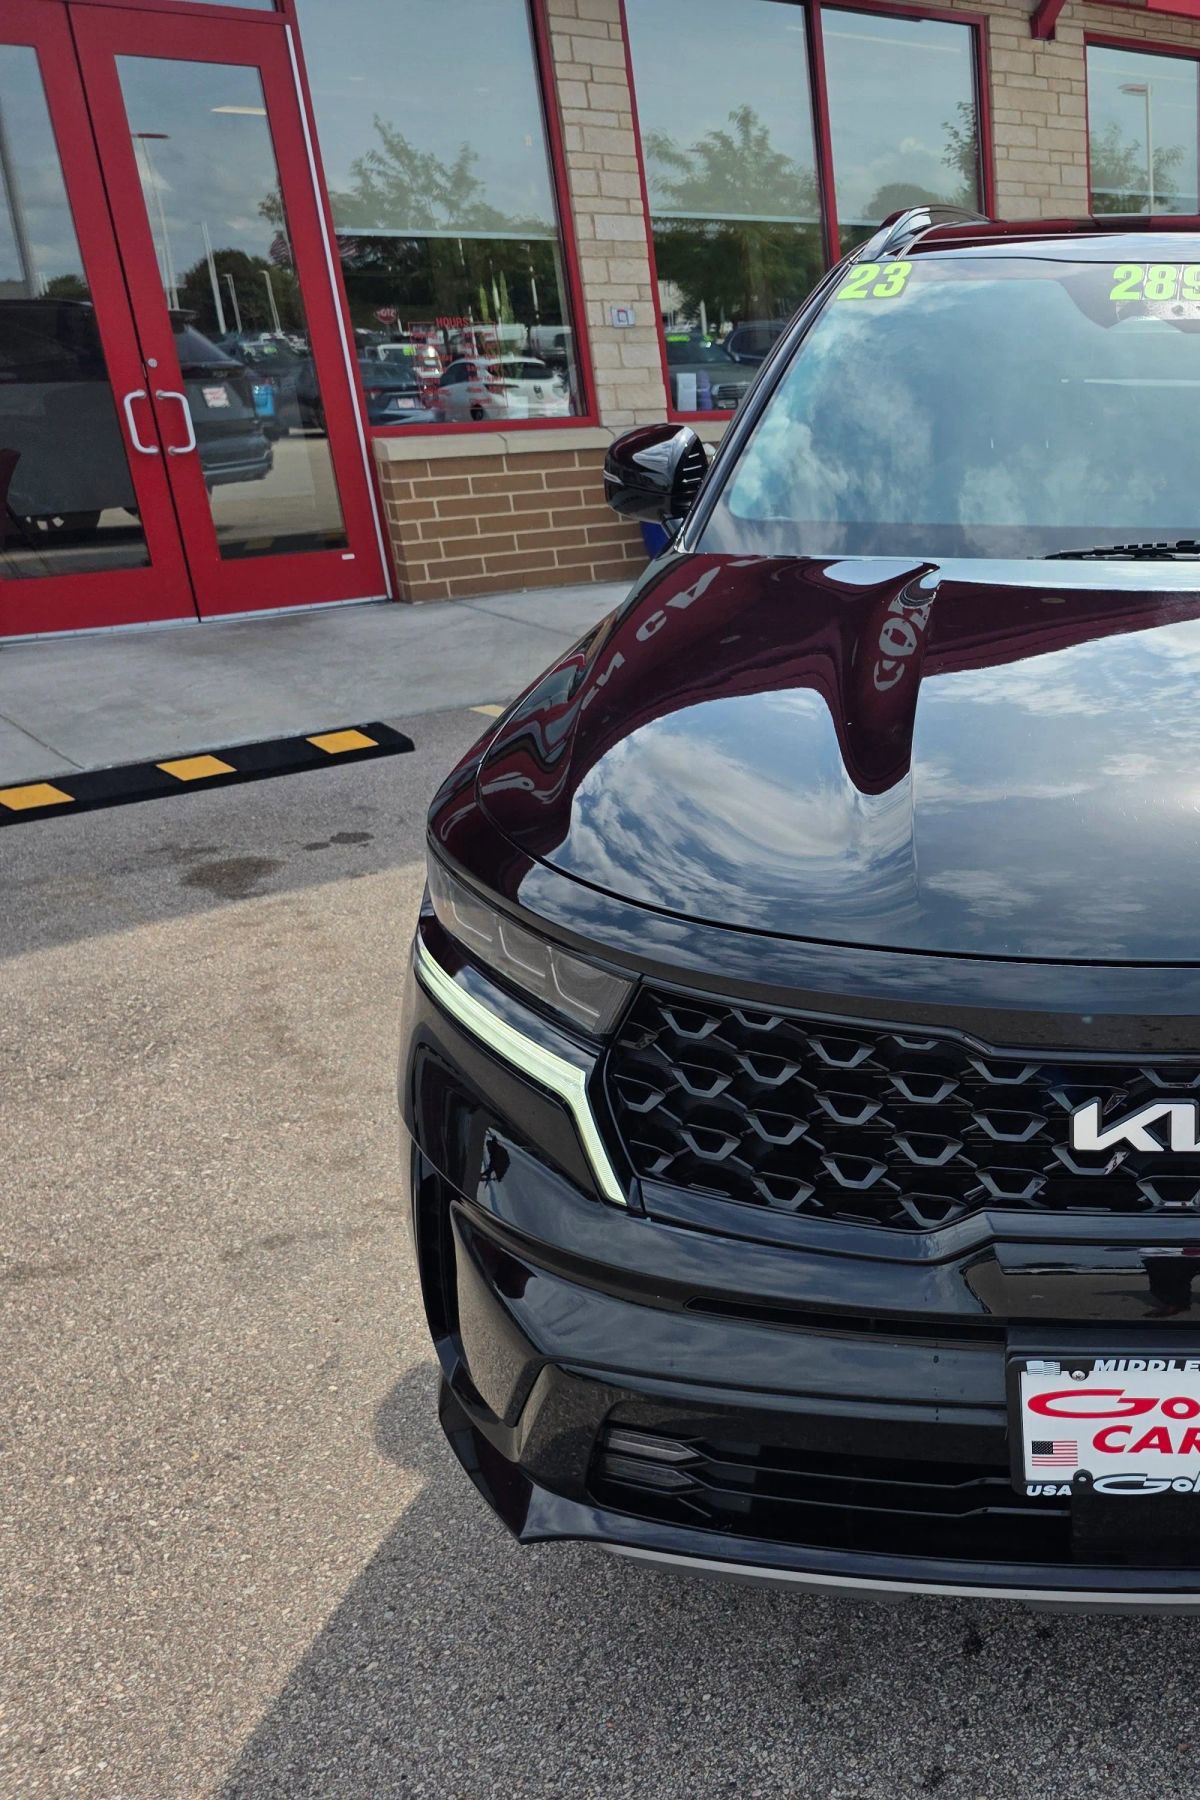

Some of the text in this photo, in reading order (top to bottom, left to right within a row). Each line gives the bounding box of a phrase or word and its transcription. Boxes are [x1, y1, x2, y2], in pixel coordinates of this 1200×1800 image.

[837, 261, 912, 300] 23
[435, 316, 470, 328] HOURS
[1026, 1484, 1073, 1497] USA
